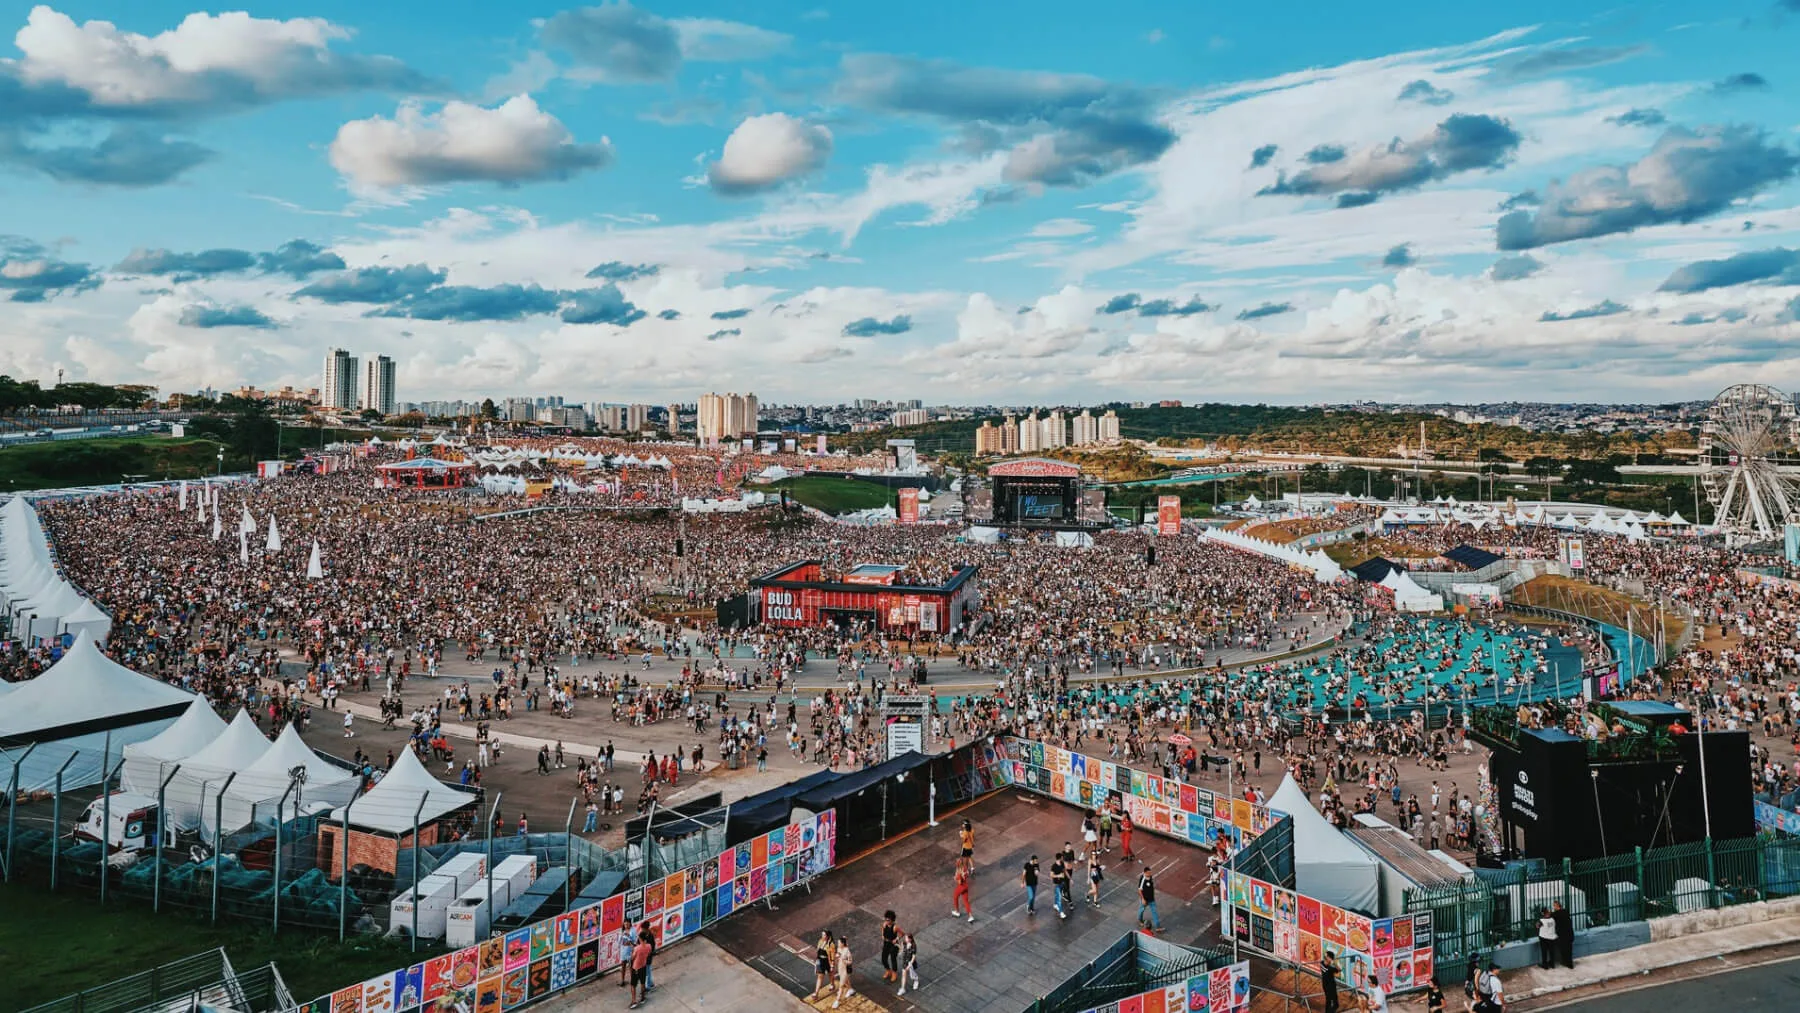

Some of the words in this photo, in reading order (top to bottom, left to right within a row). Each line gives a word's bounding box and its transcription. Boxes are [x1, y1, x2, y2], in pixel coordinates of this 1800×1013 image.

[768, 592, 792, 605] BUD
[768, 606, 802, 620] LOLLA
[450, 913, 472, 921] AIRCAM
